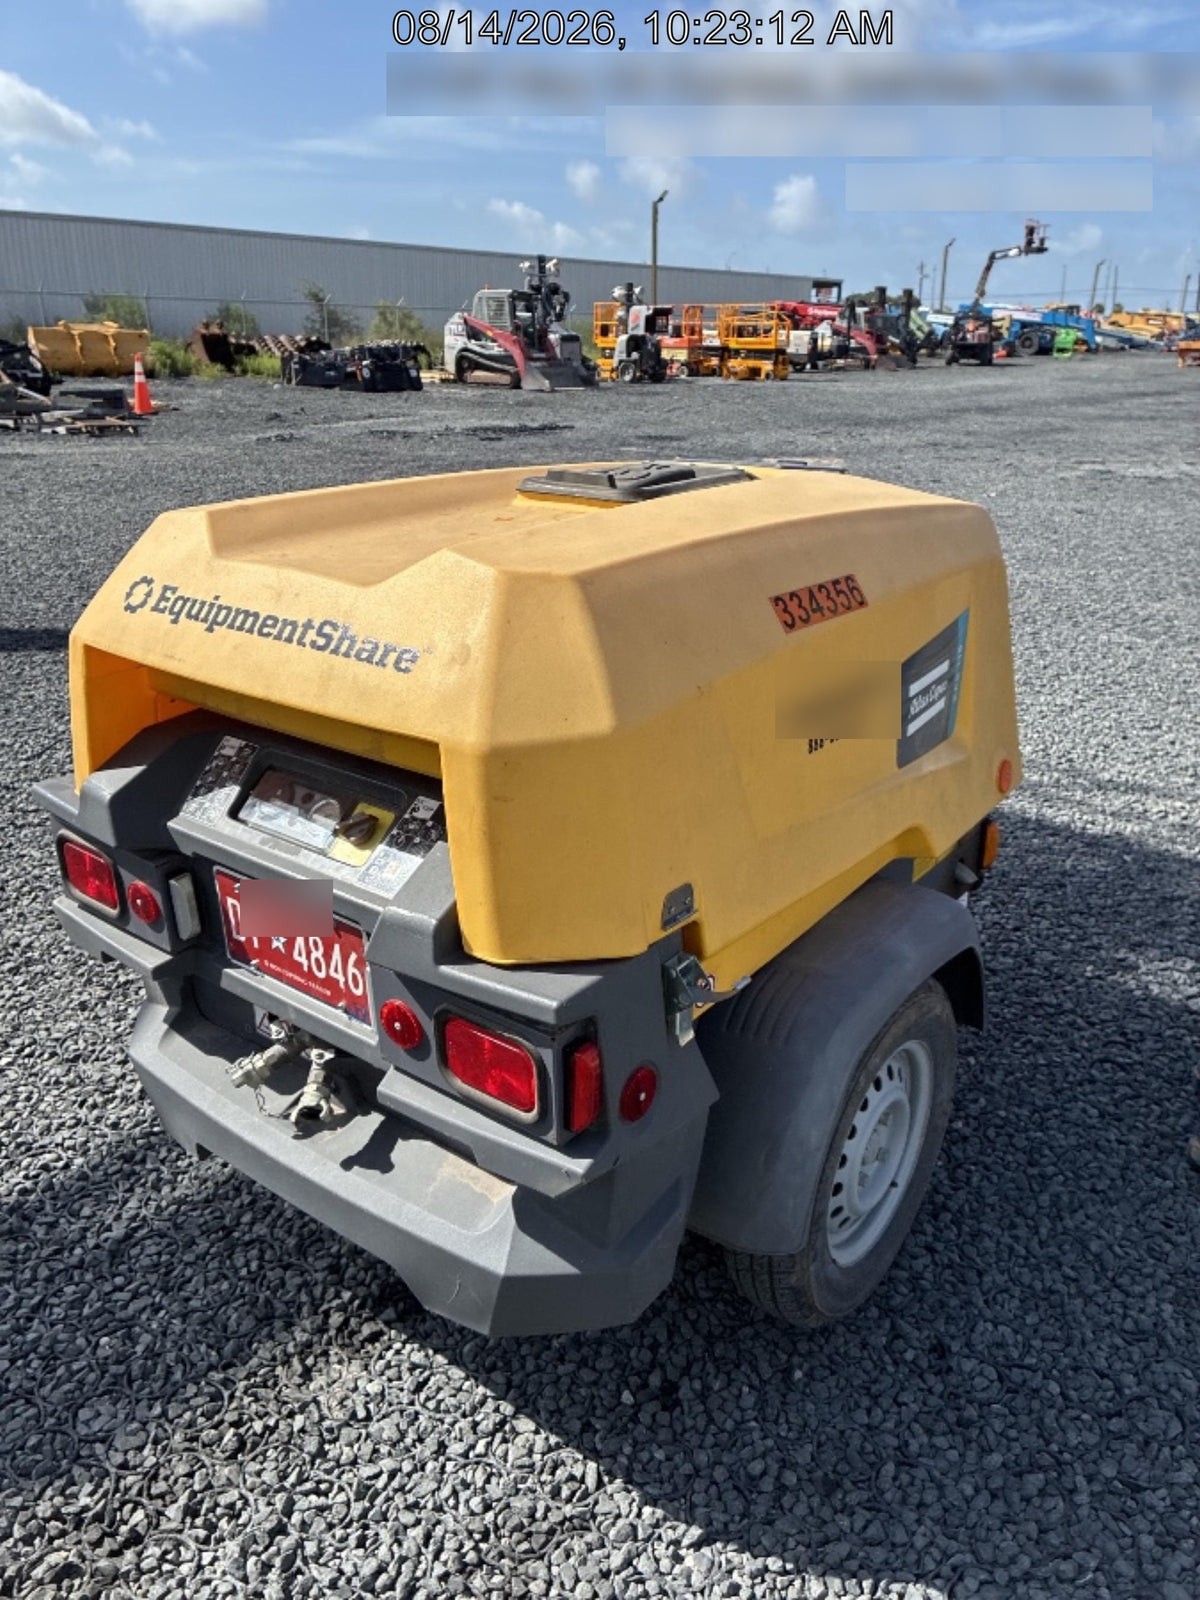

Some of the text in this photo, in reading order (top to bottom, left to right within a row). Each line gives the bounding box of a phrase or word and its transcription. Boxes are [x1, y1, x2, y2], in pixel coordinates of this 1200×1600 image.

[150, 584, 420, 675] EquipmentShare
[773, 575, 866, 630] 334356
[293, 936, 363, 996] 4846
